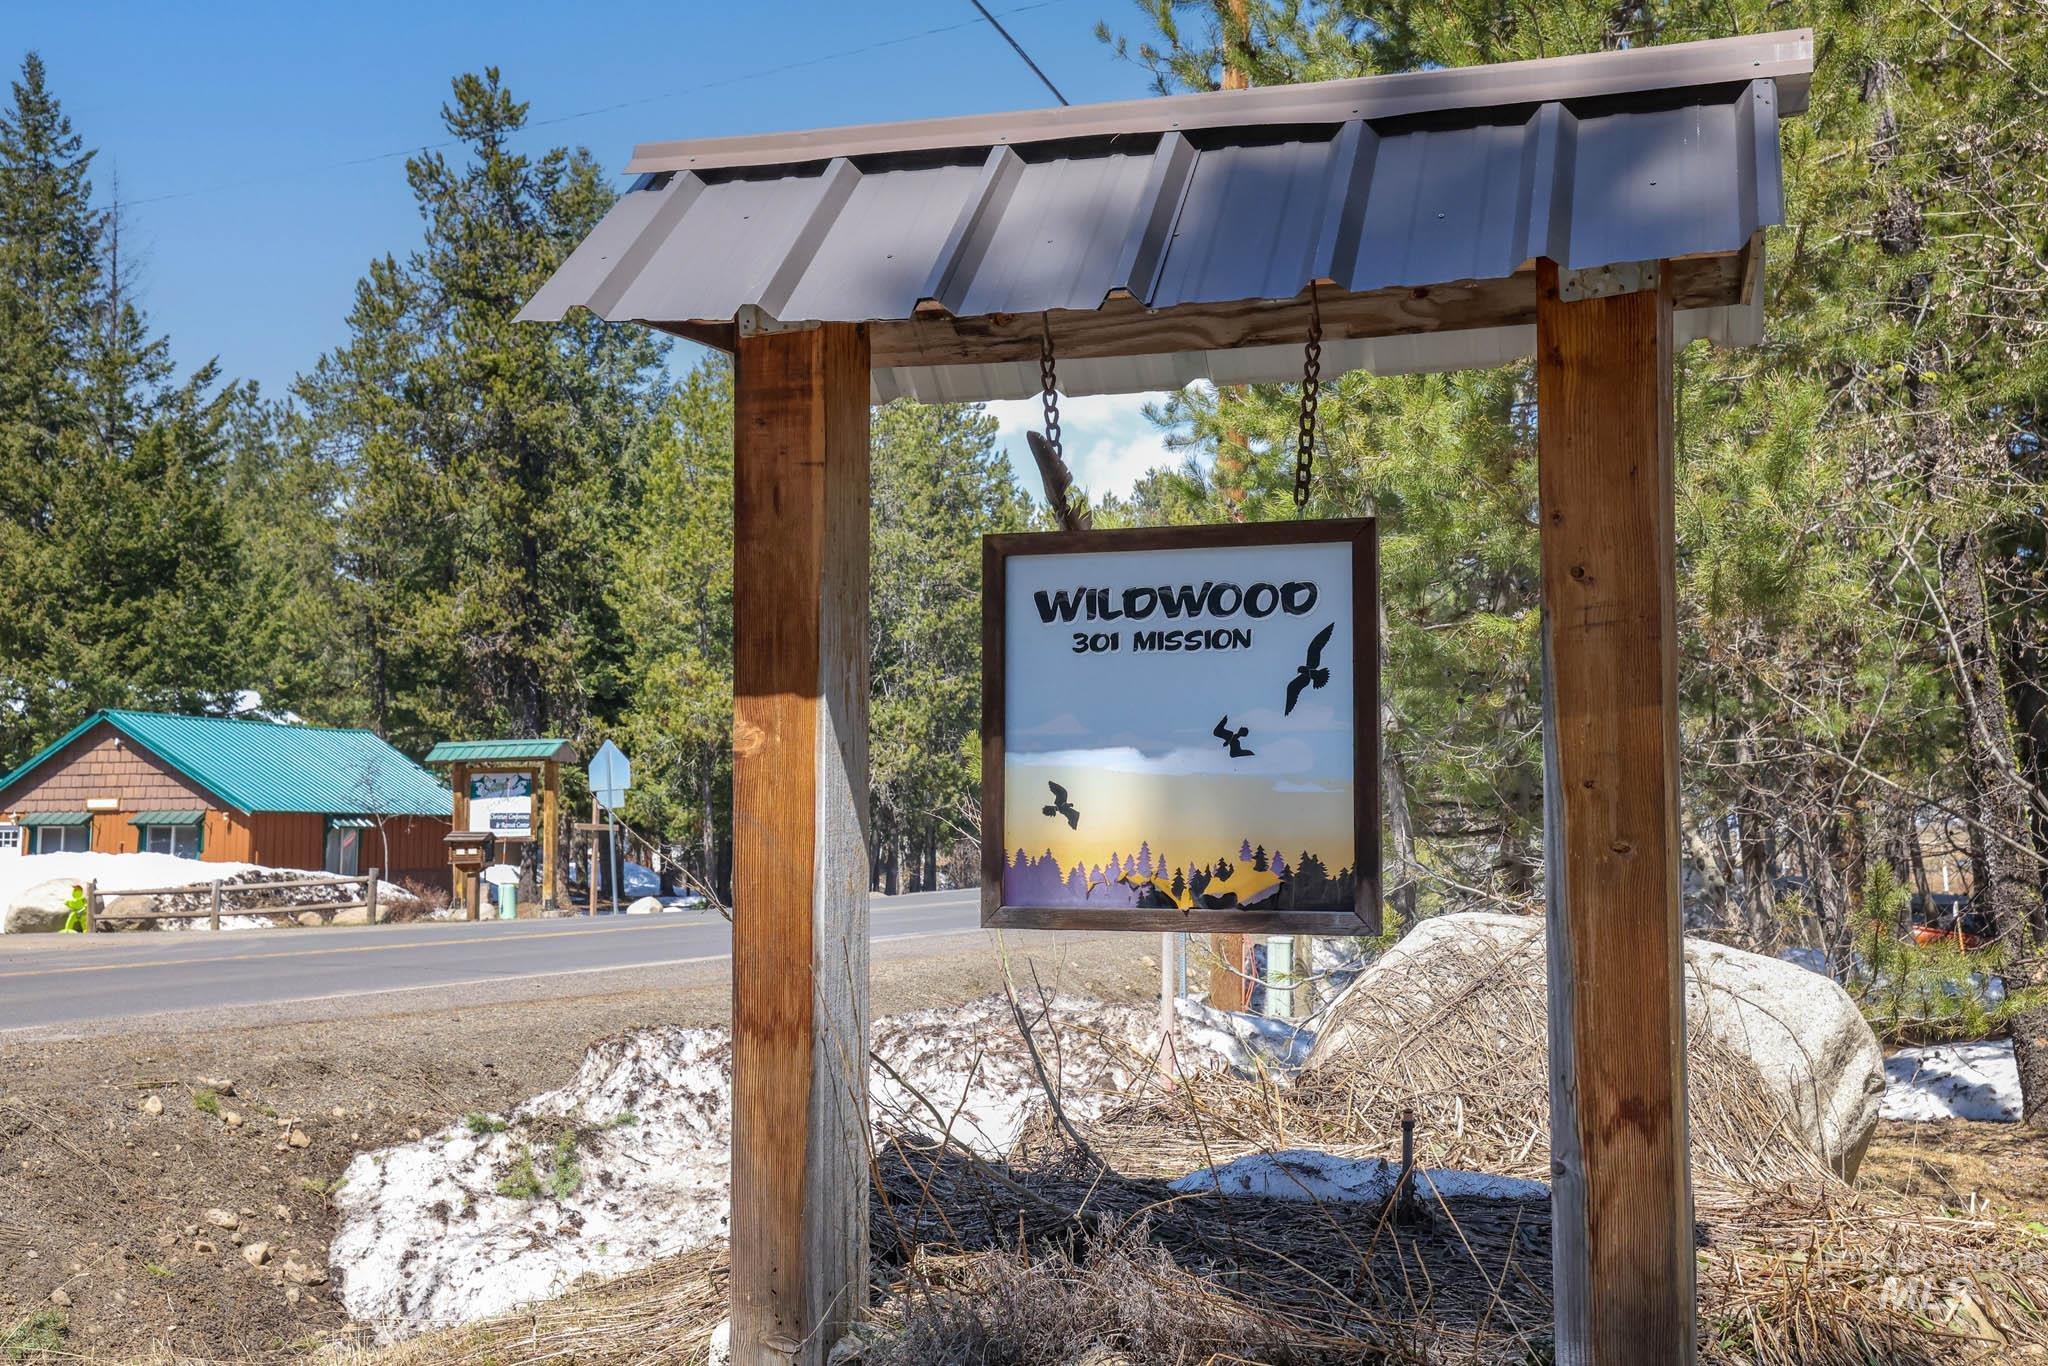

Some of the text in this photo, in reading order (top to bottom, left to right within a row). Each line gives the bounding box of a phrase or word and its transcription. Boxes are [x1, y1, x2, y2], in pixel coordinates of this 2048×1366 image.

[1033, 581, 1318, 624] WILDWOOD
[1071, 628, 1252, 654] 301 MISSION
